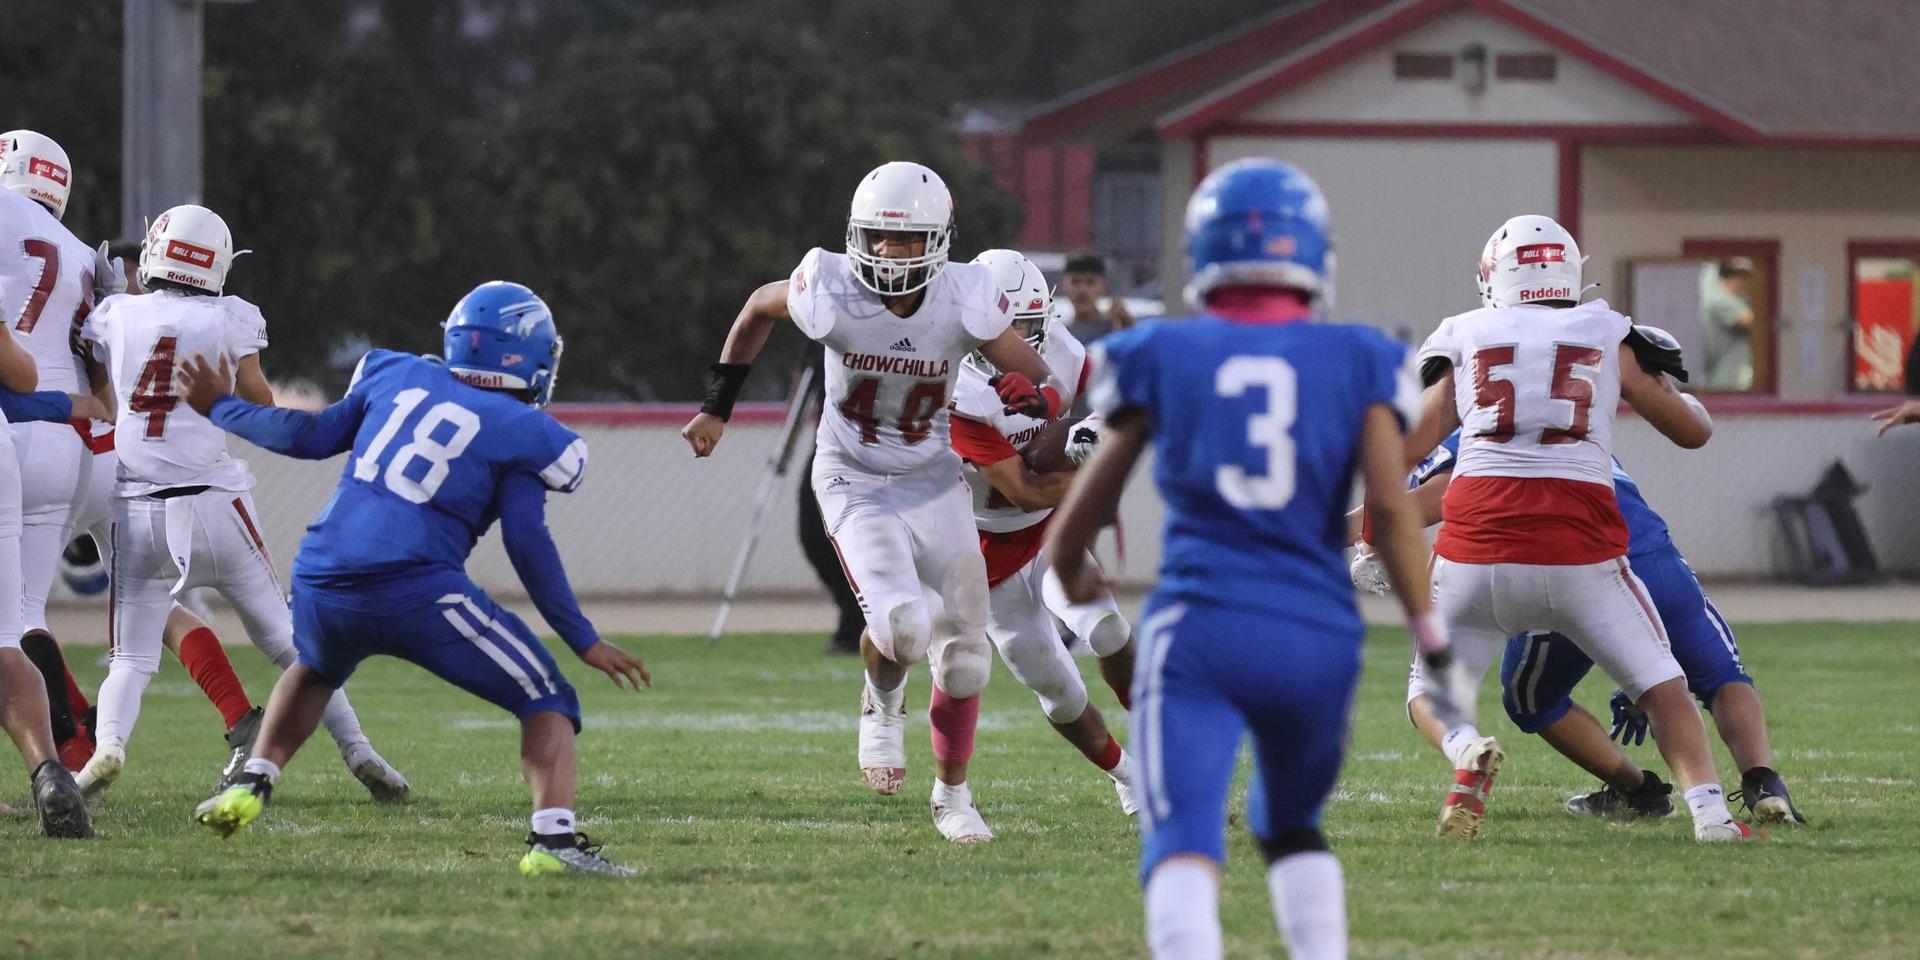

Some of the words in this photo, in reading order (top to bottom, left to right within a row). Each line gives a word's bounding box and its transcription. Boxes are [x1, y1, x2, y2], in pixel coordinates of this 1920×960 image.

[167, 271, 206, 287] Riddell
[1522, 250, 1540, 259] ROLL
[1520, 287, 1570, 300] Riddell
[129, 336, 178, 438] 4
[842, 352, 949, 377] CHOWCHILLA
[1473, 344, 1602, 444] 55
[841, 378, 945, 444] 40
[1215, 354, 1297, 511] 3
[353, 387, 480, 504] 18
